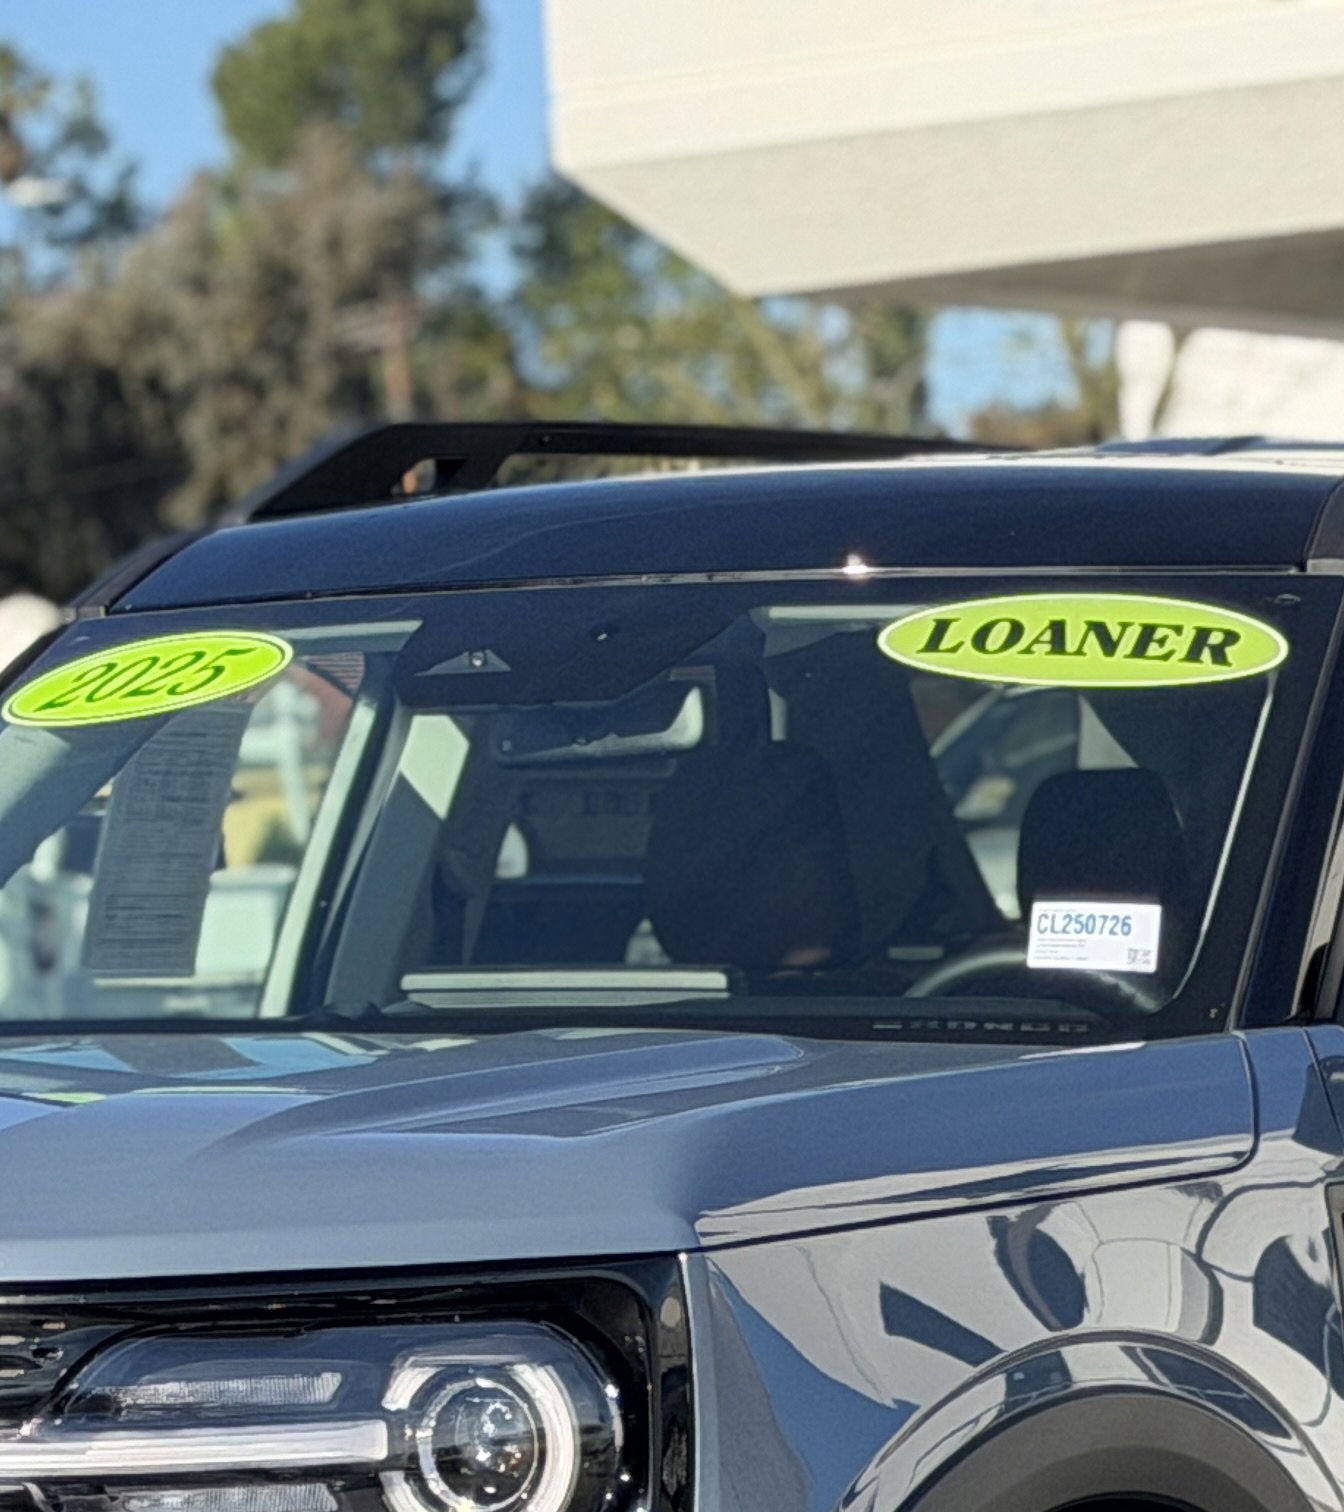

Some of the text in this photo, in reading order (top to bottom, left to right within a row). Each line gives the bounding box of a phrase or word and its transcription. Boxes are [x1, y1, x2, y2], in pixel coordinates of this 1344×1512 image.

[917, 618, 1242, 667] LOANER
[32, 646, 259, 713] 2025
[1036, 912, 1133, 937] CL250726
